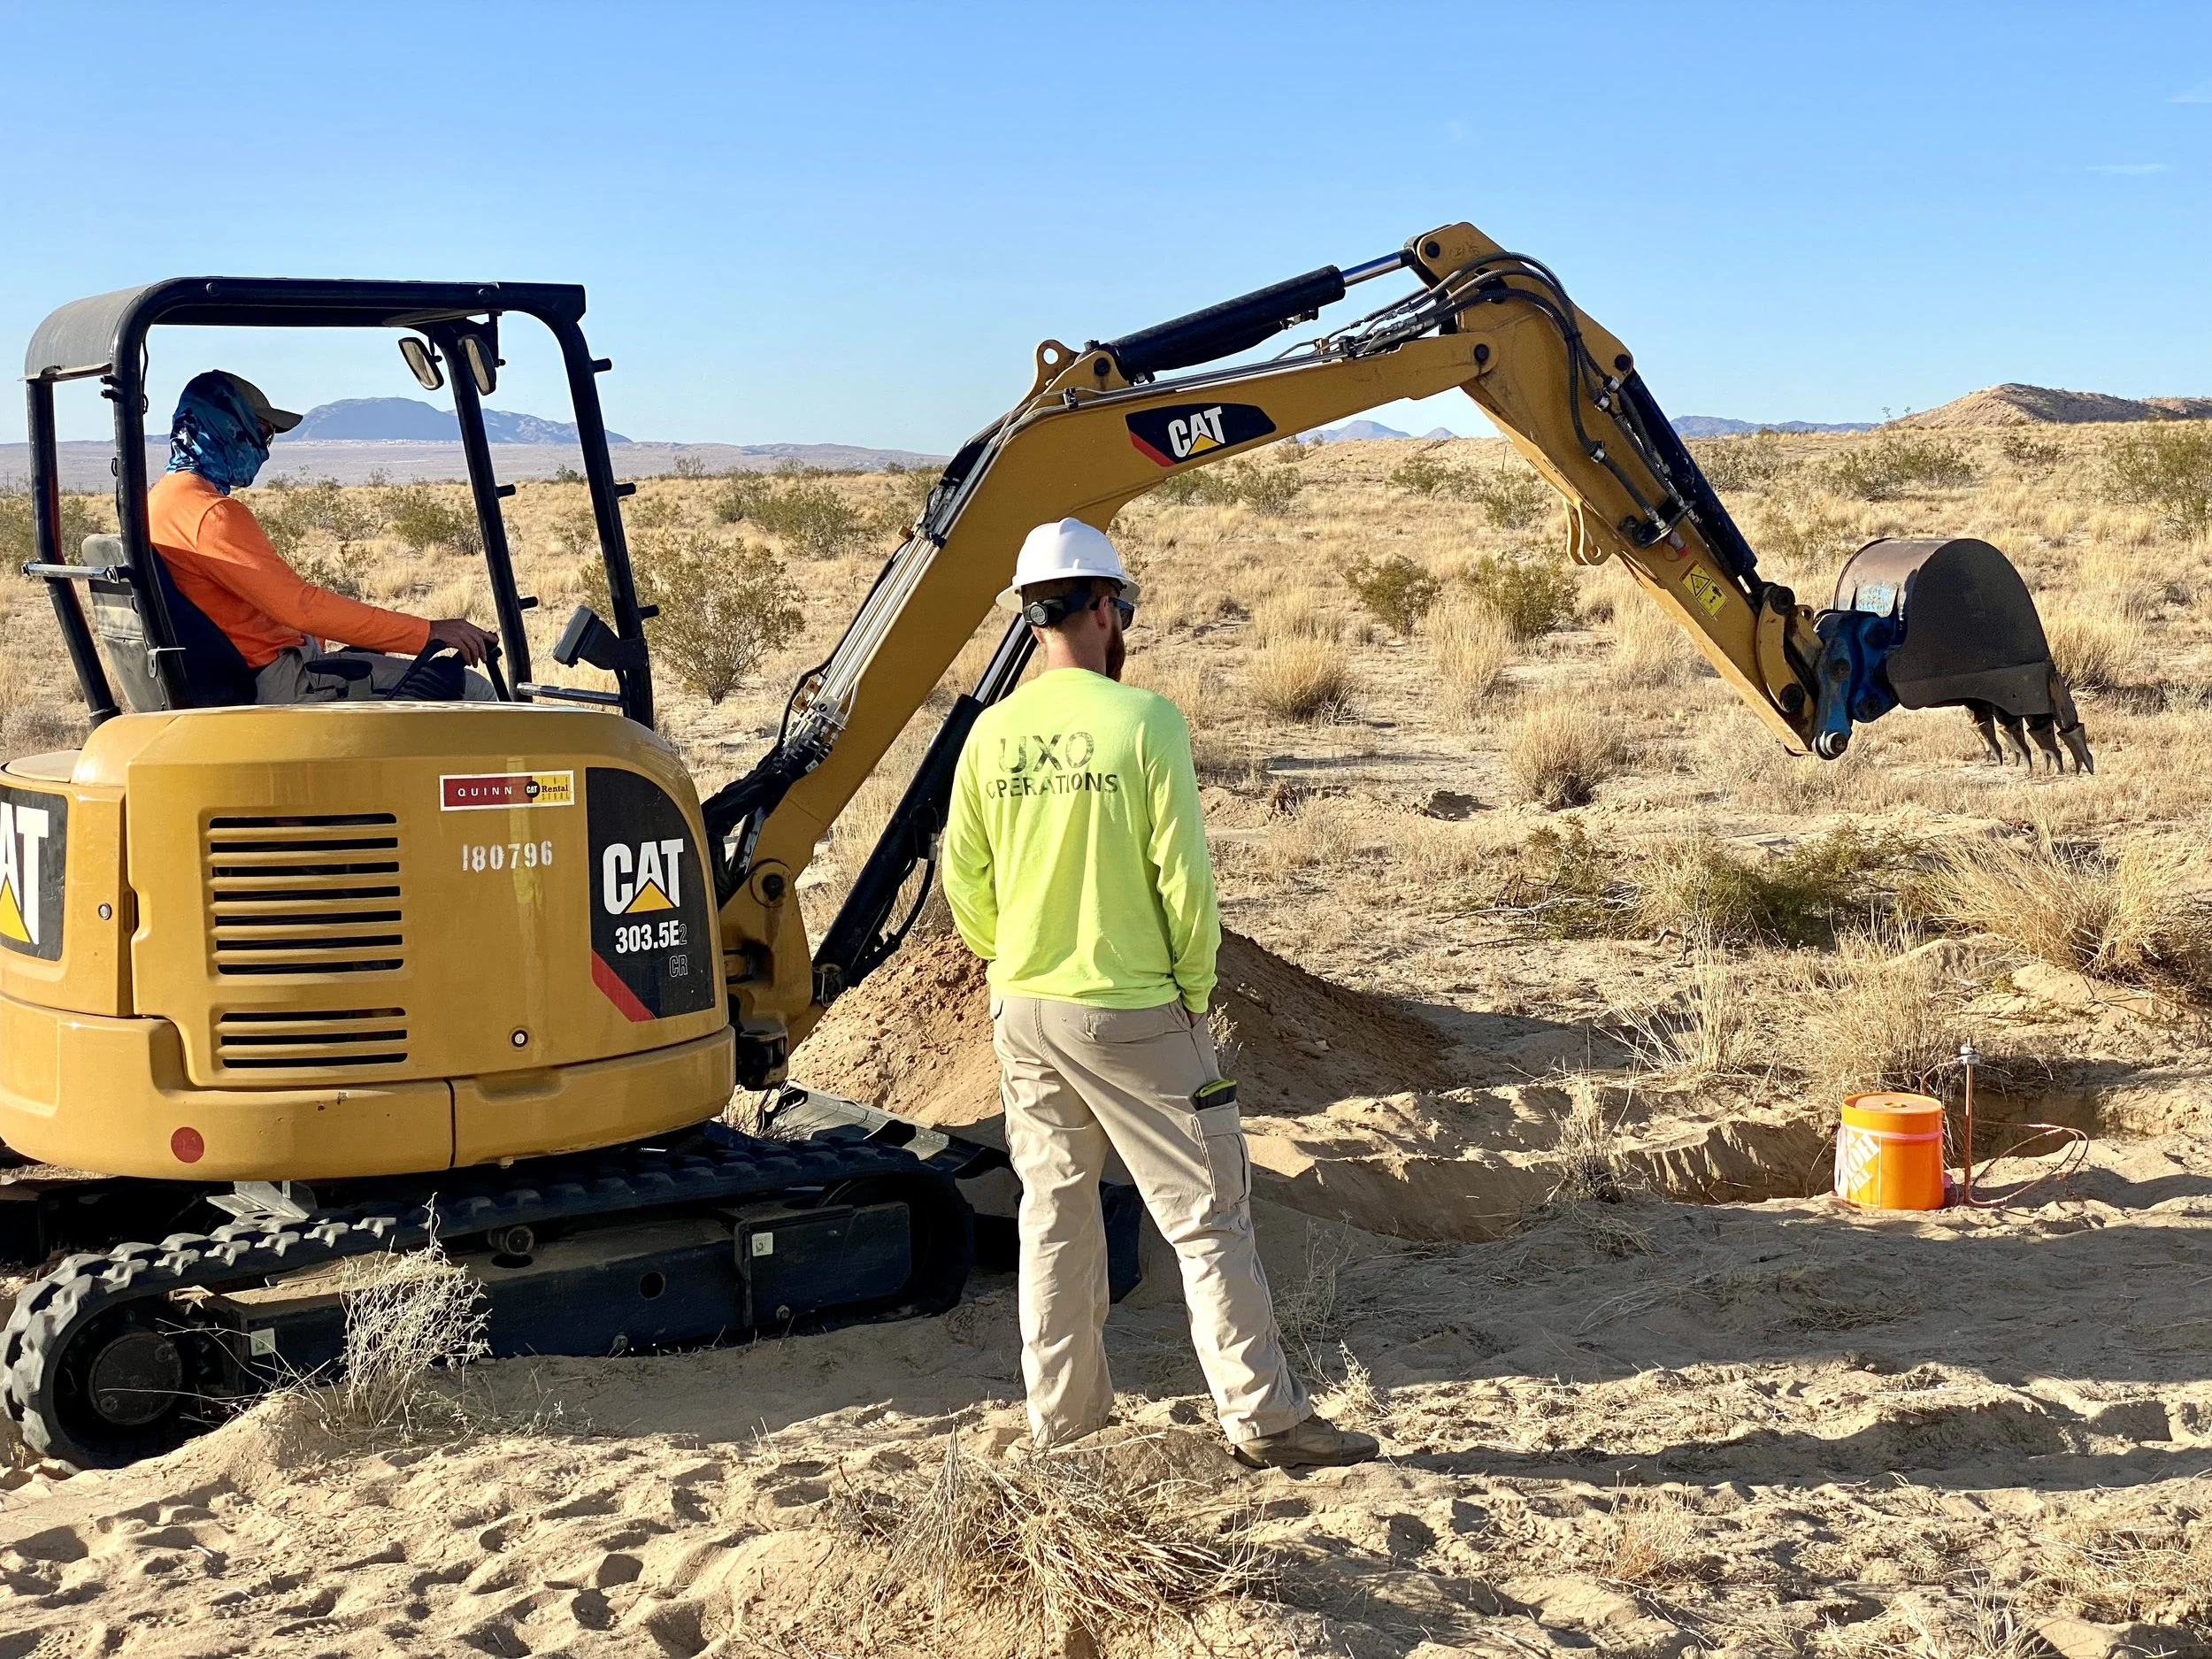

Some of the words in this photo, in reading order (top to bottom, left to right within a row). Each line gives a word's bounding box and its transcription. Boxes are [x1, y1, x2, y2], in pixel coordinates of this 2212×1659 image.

[1168, 406, 1225, 457] CAT
[999, 732, 1094, 773] UXO
[457, 787, 512, 796] QUINN
[526, 785, 538, 794] CAT
[541, 784, 568, 793] Rental
[986, 772, 1118, 799] OPERATIONS
[463, 840, 553, 872] 180796
[0, 801, 50, 945] AT
[603, 838, 684, 915] CAT
[669, 954, 688, 978] CR
